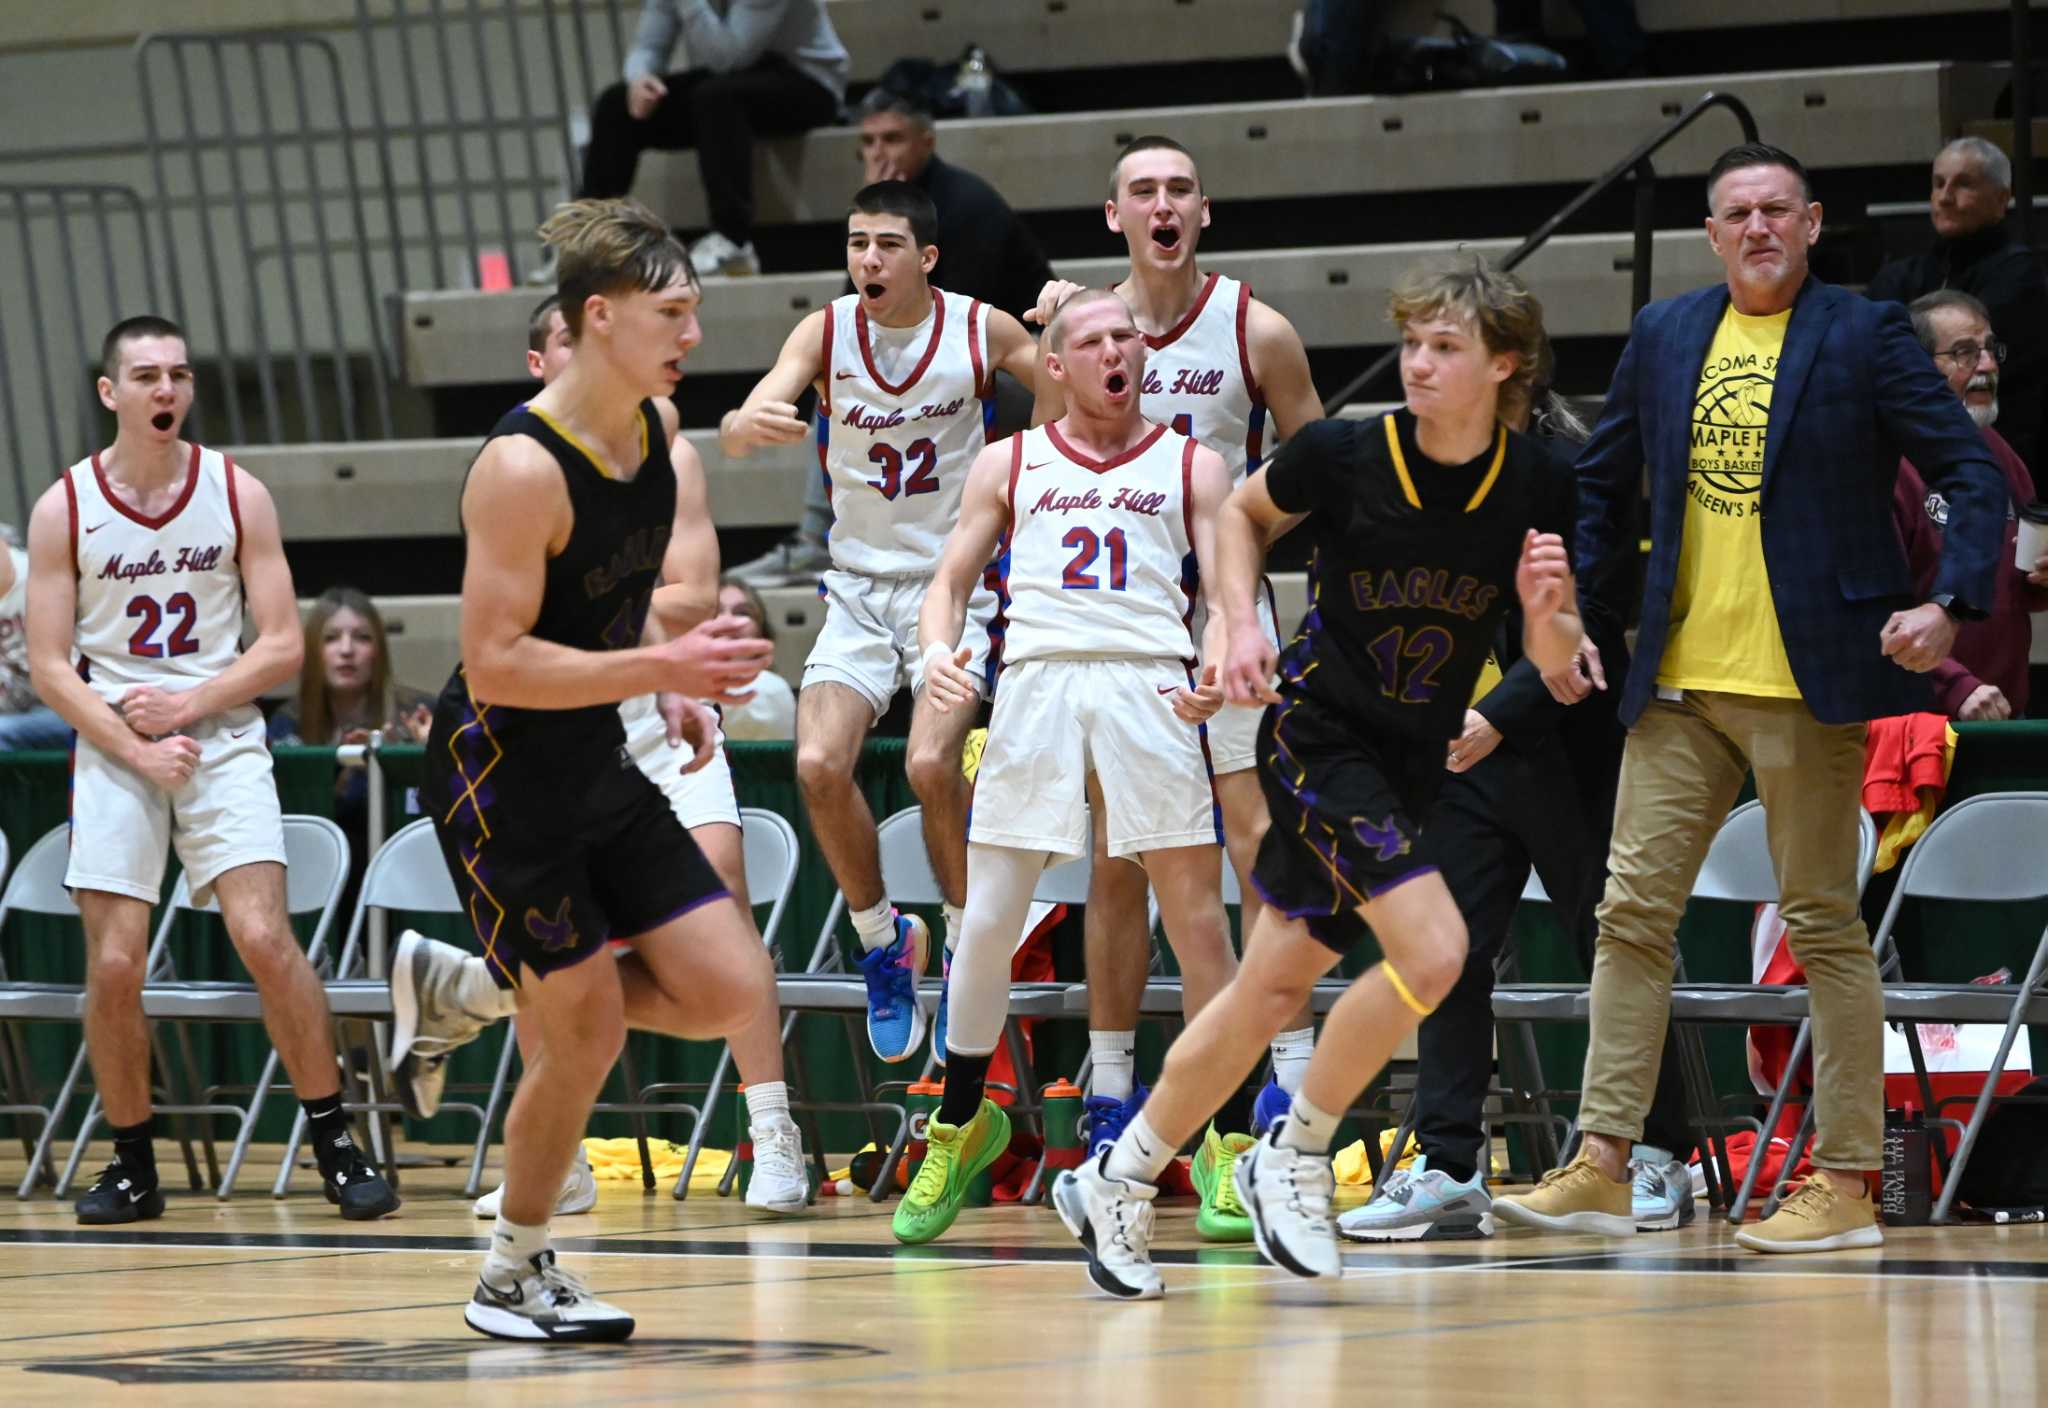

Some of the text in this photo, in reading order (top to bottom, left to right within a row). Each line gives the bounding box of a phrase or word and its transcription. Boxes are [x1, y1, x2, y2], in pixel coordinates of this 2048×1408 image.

[1170, 369, 1224, 395] Hill
[1698, 354, 1758, 384] CONA
[842, 398, 964, 435] Maple Hill
[1691, 427, 1750, 448] MAPLE
[867, 438, 939, 501] 32
[1692, 459, 1720, 470] BOYS
[1030, 487, 1166, 516] Maple Hill
[1687, 479, 1744, 518] AILEEN'S
[98, 546, 222, 584] Maple Hill
[1062, 526, 1127, 591] 21
[1350, 567, 1498, 620] EAGLES
[126, 592, 199, 658] 22
[1367, 626, 1453, 703] 12
